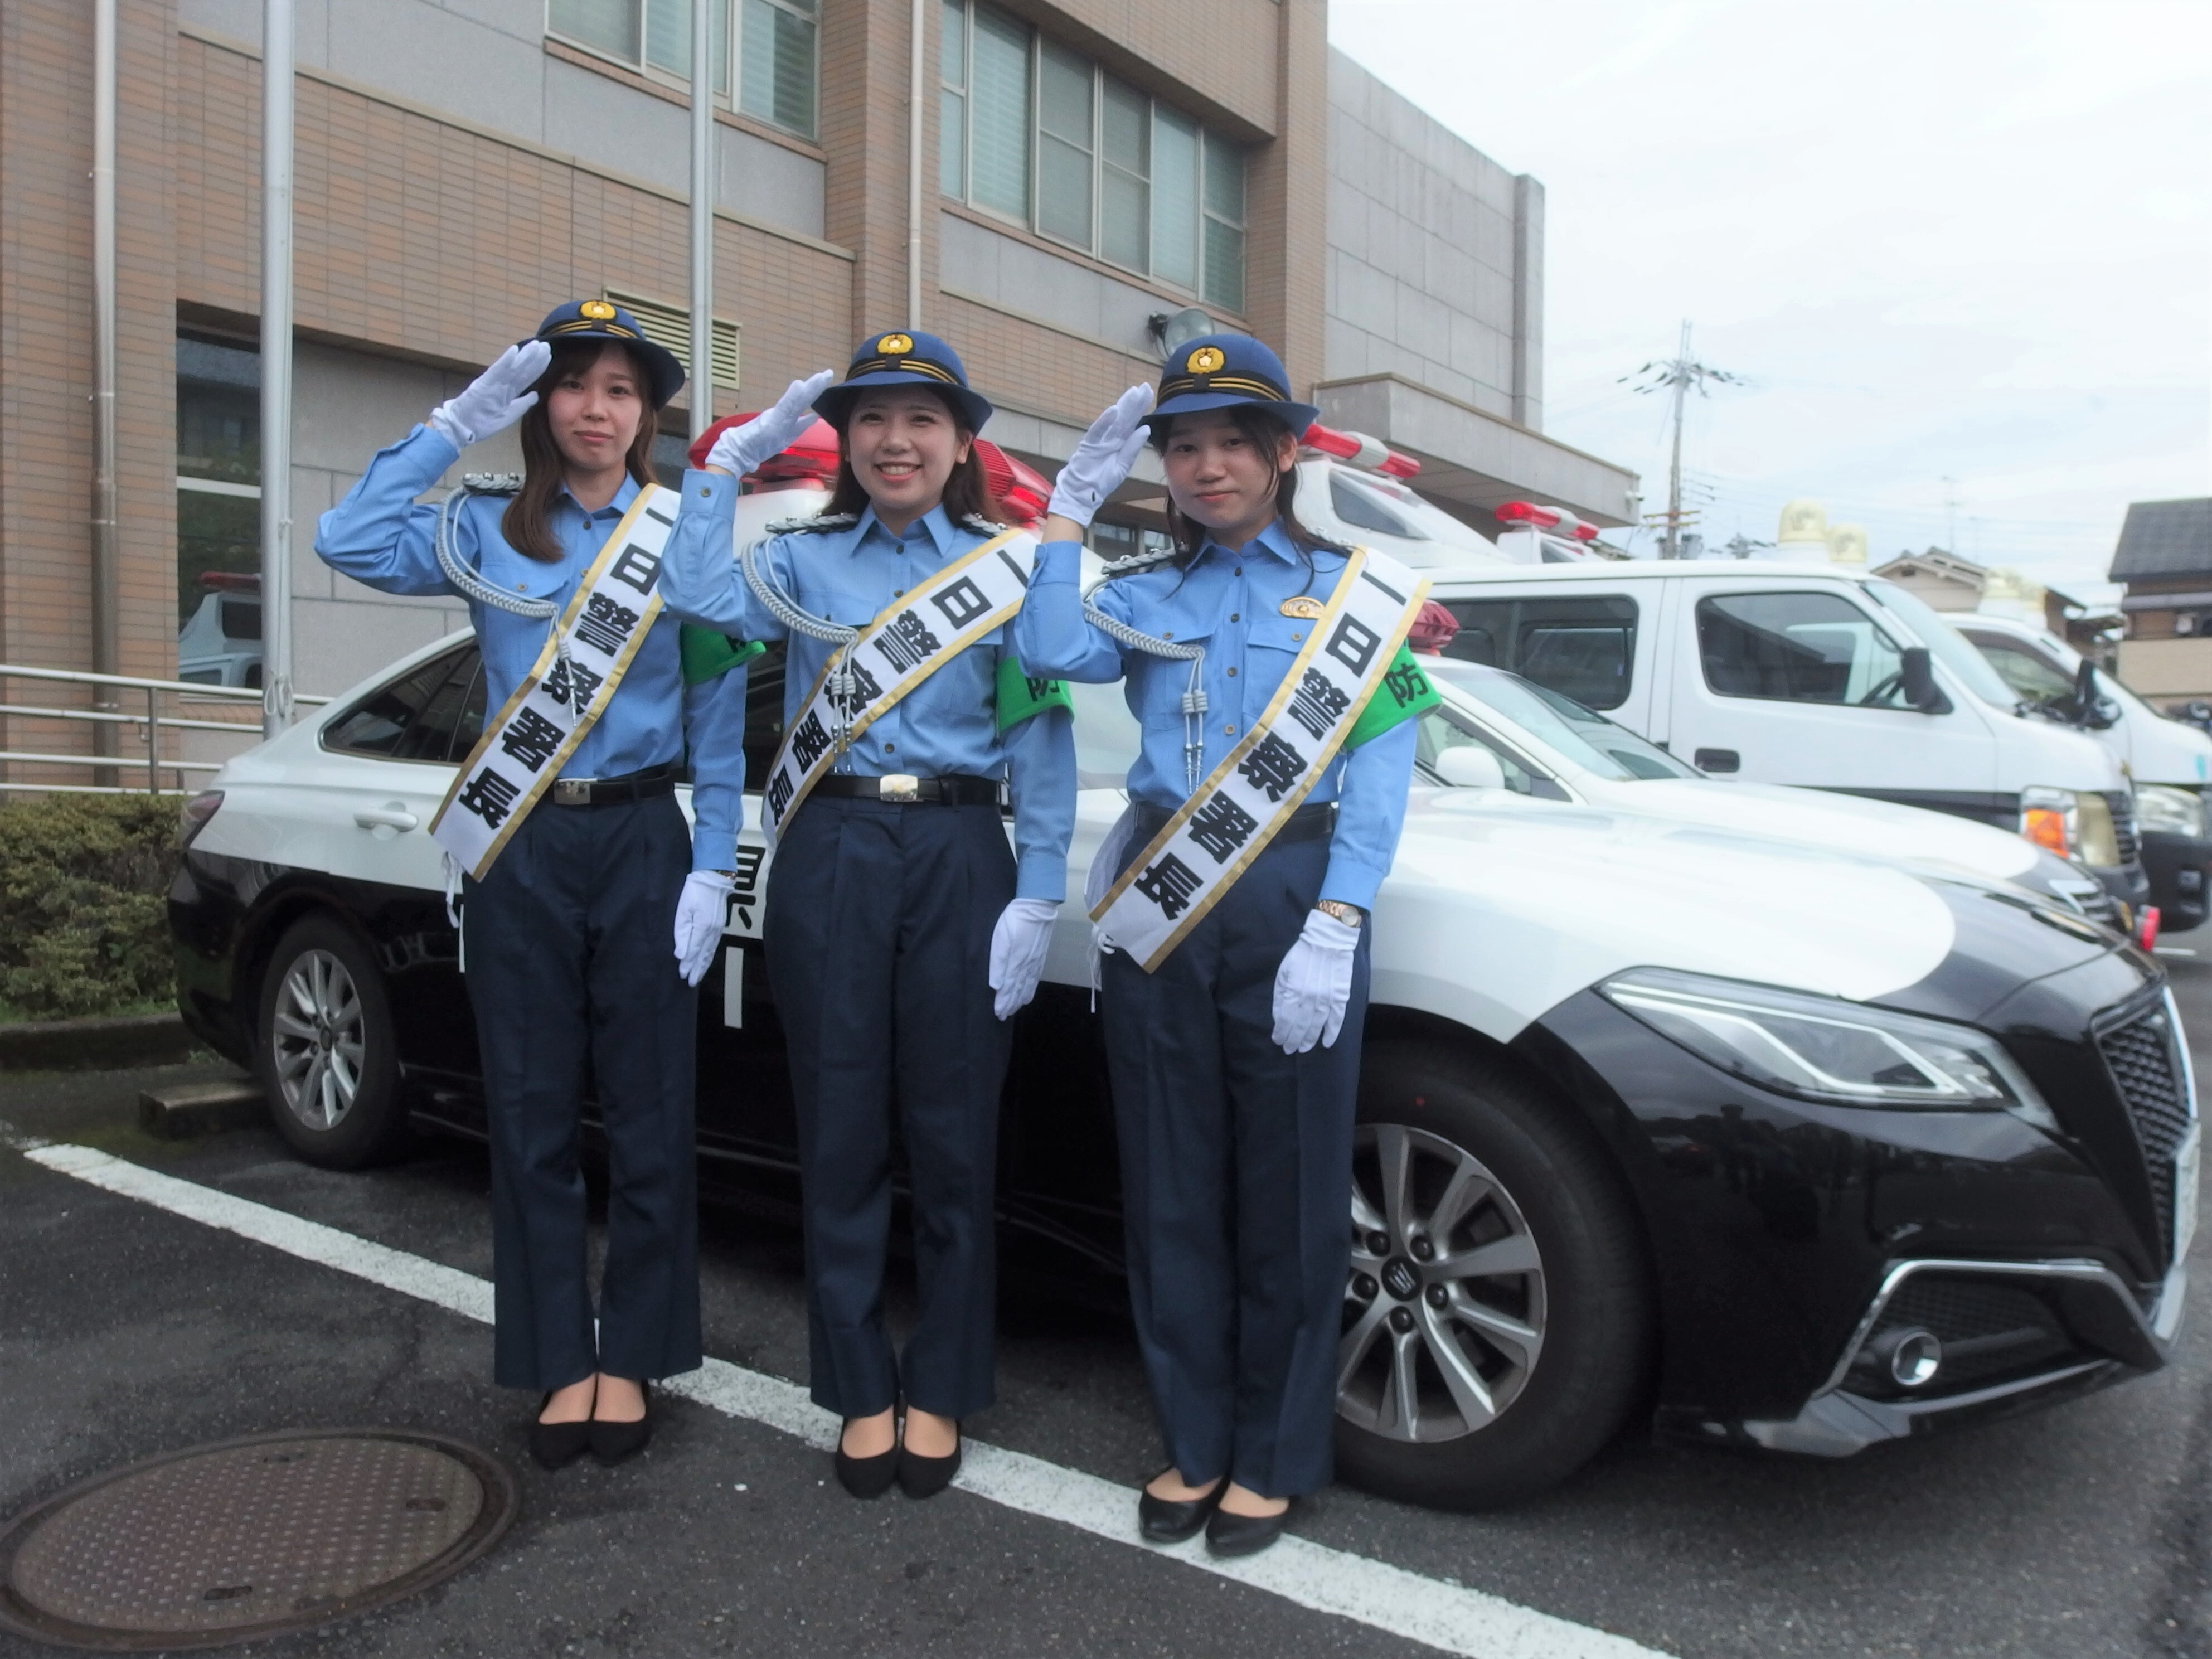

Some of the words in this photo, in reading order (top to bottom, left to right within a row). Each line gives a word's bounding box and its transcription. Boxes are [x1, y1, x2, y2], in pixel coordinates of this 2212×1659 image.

[459, 507, 673, 830] 一日警察署長
[1134, 570, 1407, 921] 一日警察署長
[1384, 662, 1429, 709] 防
